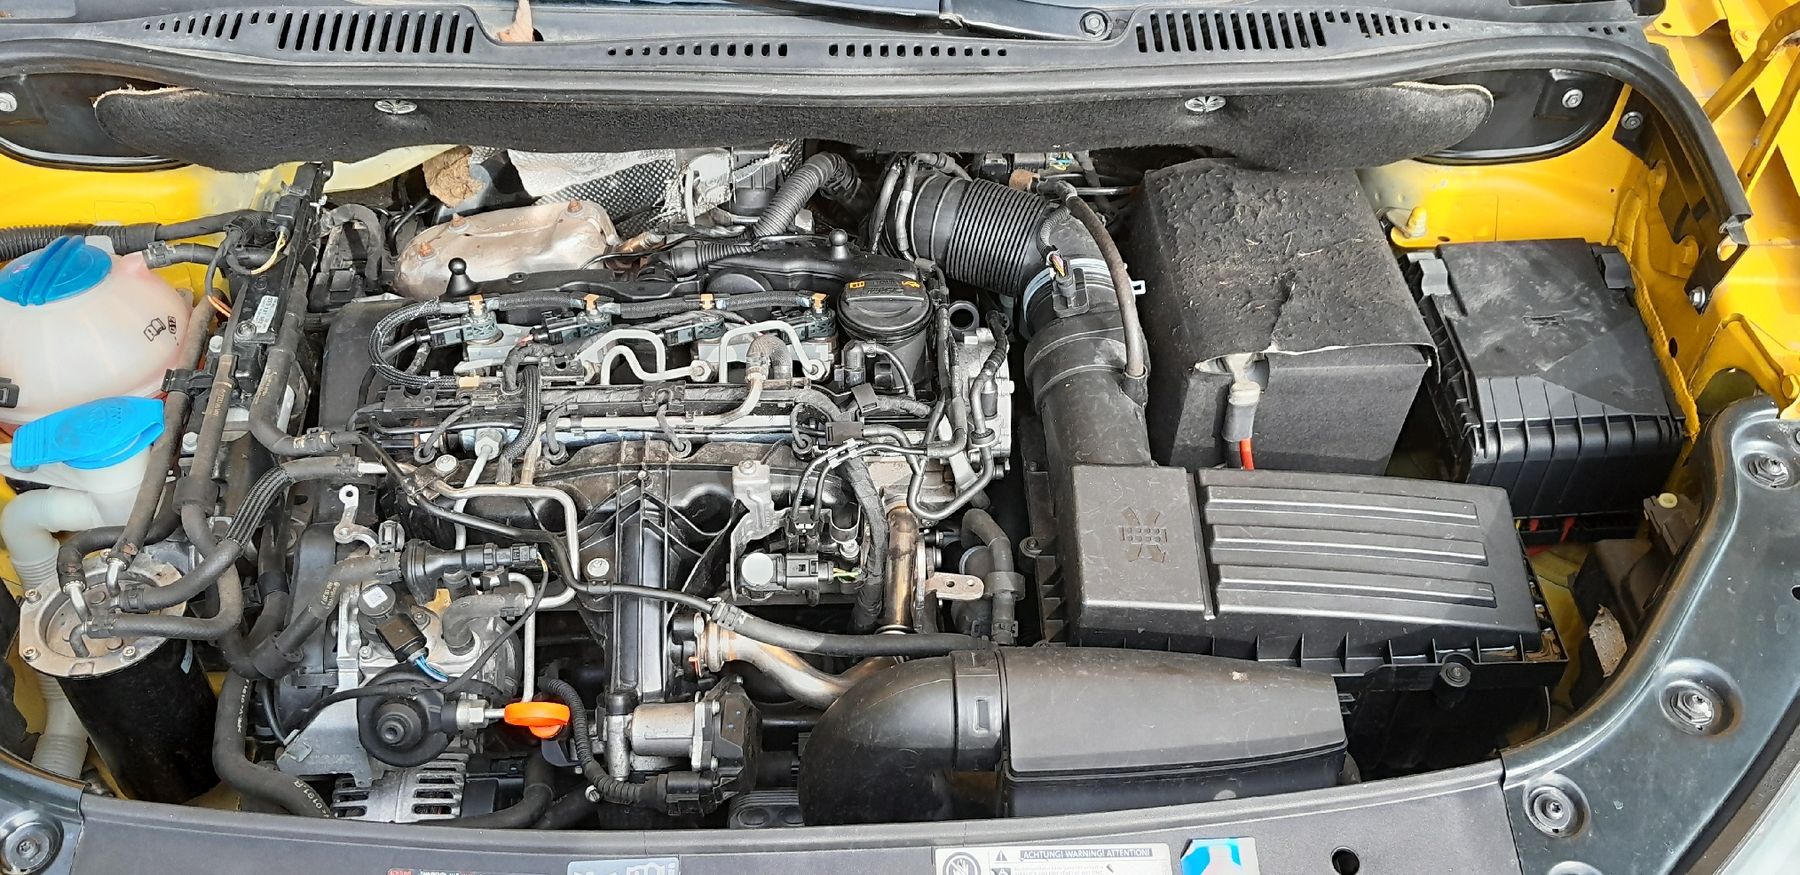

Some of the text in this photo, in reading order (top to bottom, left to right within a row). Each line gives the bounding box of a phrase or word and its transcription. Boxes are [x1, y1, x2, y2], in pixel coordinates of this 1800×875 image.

[1023, 848, 1150, 859] ACHTUNG! WARNING! ATTENTION!
